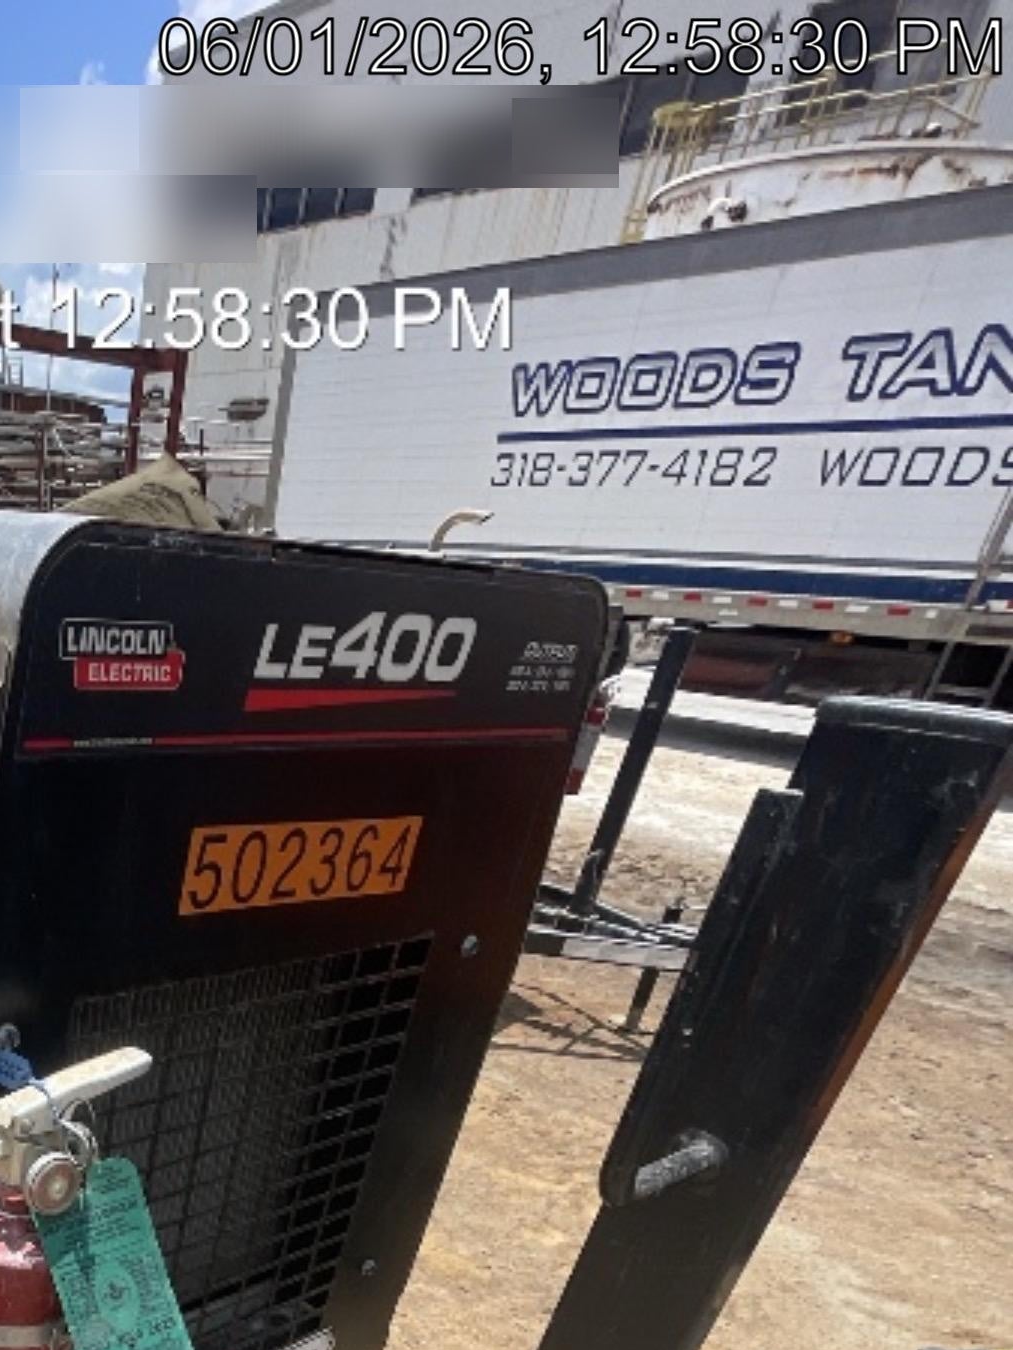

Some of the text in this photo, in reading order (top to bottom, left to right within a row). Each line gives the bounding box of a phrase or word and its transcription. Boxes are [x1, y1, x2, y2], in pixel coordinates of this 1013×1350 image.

[512, 323, 1013, 417] WOODS TAN
[490, 447, 778, 487] 318-377-4182
[67, 625, 166, 656] LINCOLN
[252, 611, 477, 682] LE400
[88, 662, 172, 684] ELECTRIC
[188, 822, 412, 910] 502364
